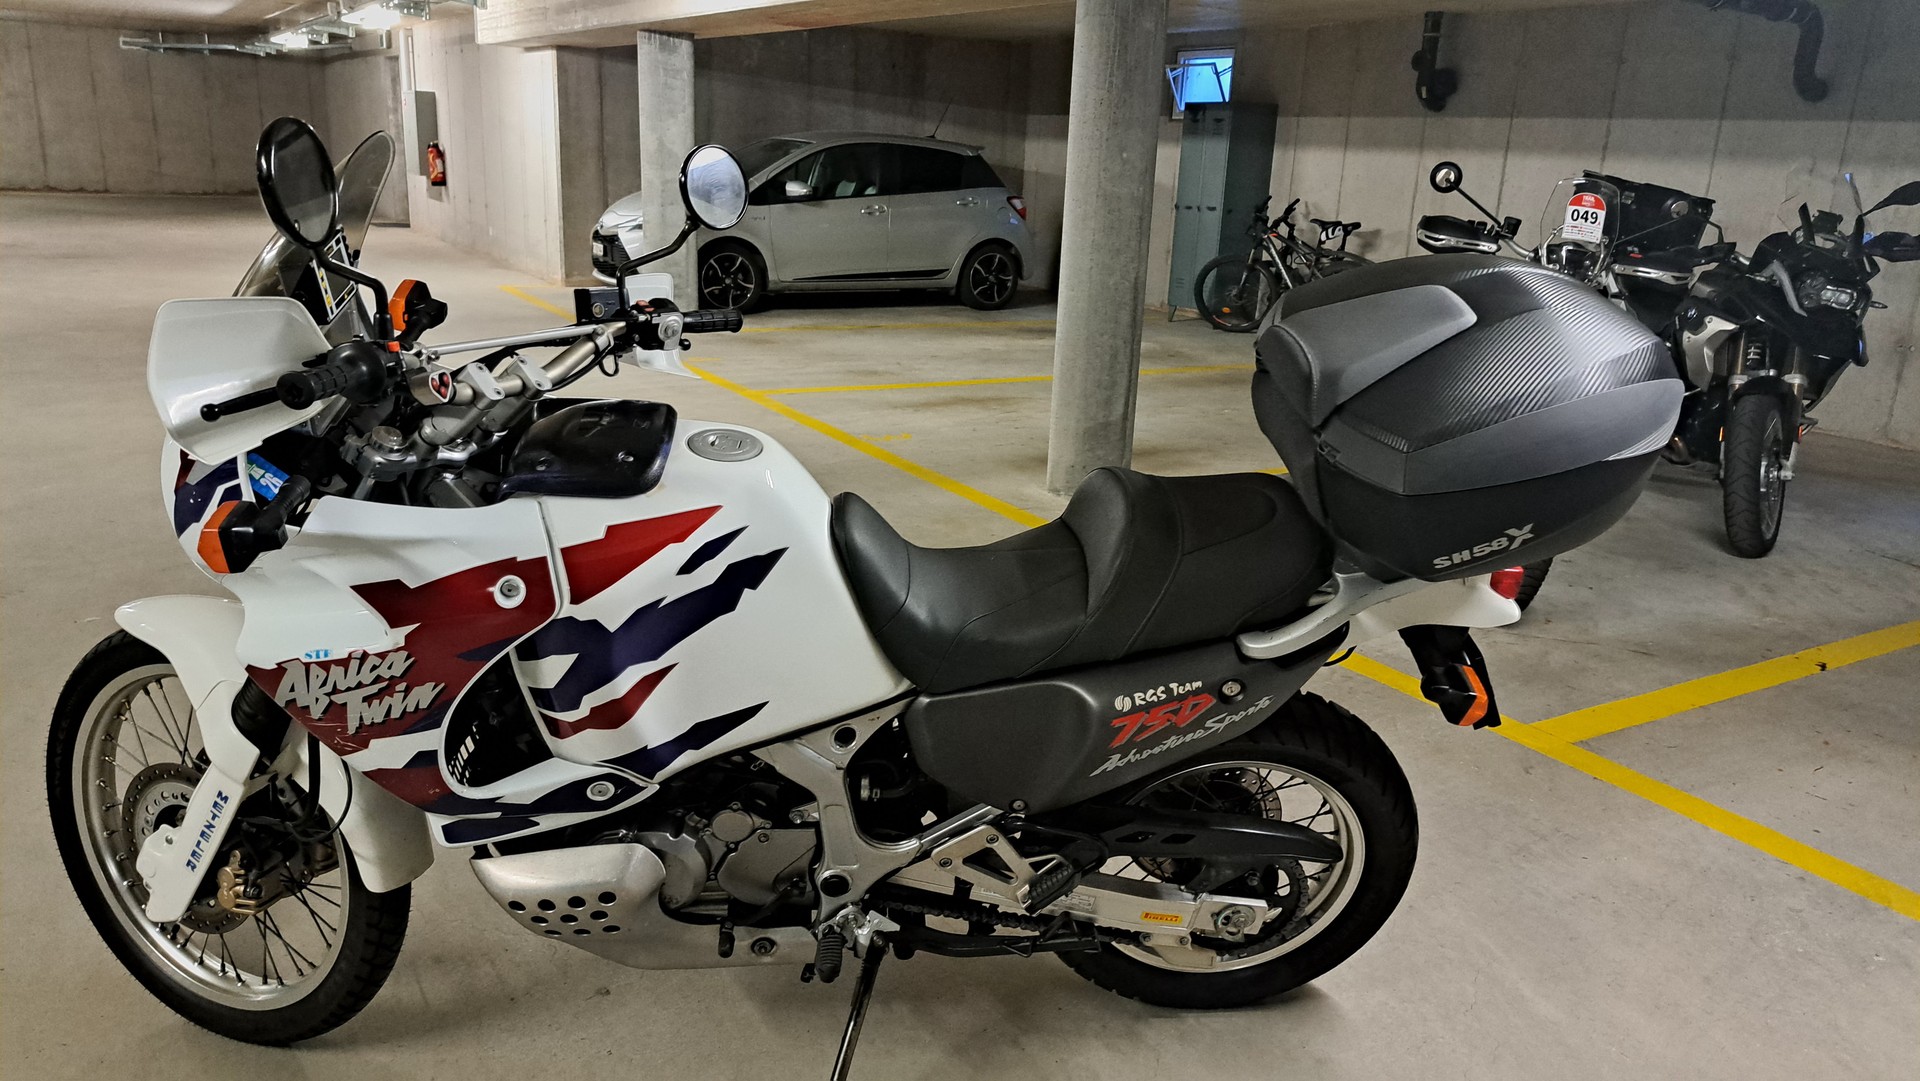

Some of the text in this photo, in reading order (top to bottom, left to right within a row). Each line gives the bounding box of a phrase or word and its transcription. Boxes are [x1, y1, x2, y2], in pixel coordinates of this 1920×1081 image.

[1571, 209, 1598, 224] 049
[260, 472, 284, 494] 26
[1433, 523, 1534, 569] SH58X
[274, 649, 417, 720] Africa
[330, 681, 446, 735] Twin
[1134, 680, 1203, 706] RGS Team
[1109, 693, 1217, 748] 750
[186, 790, 229, 872] METZELER
